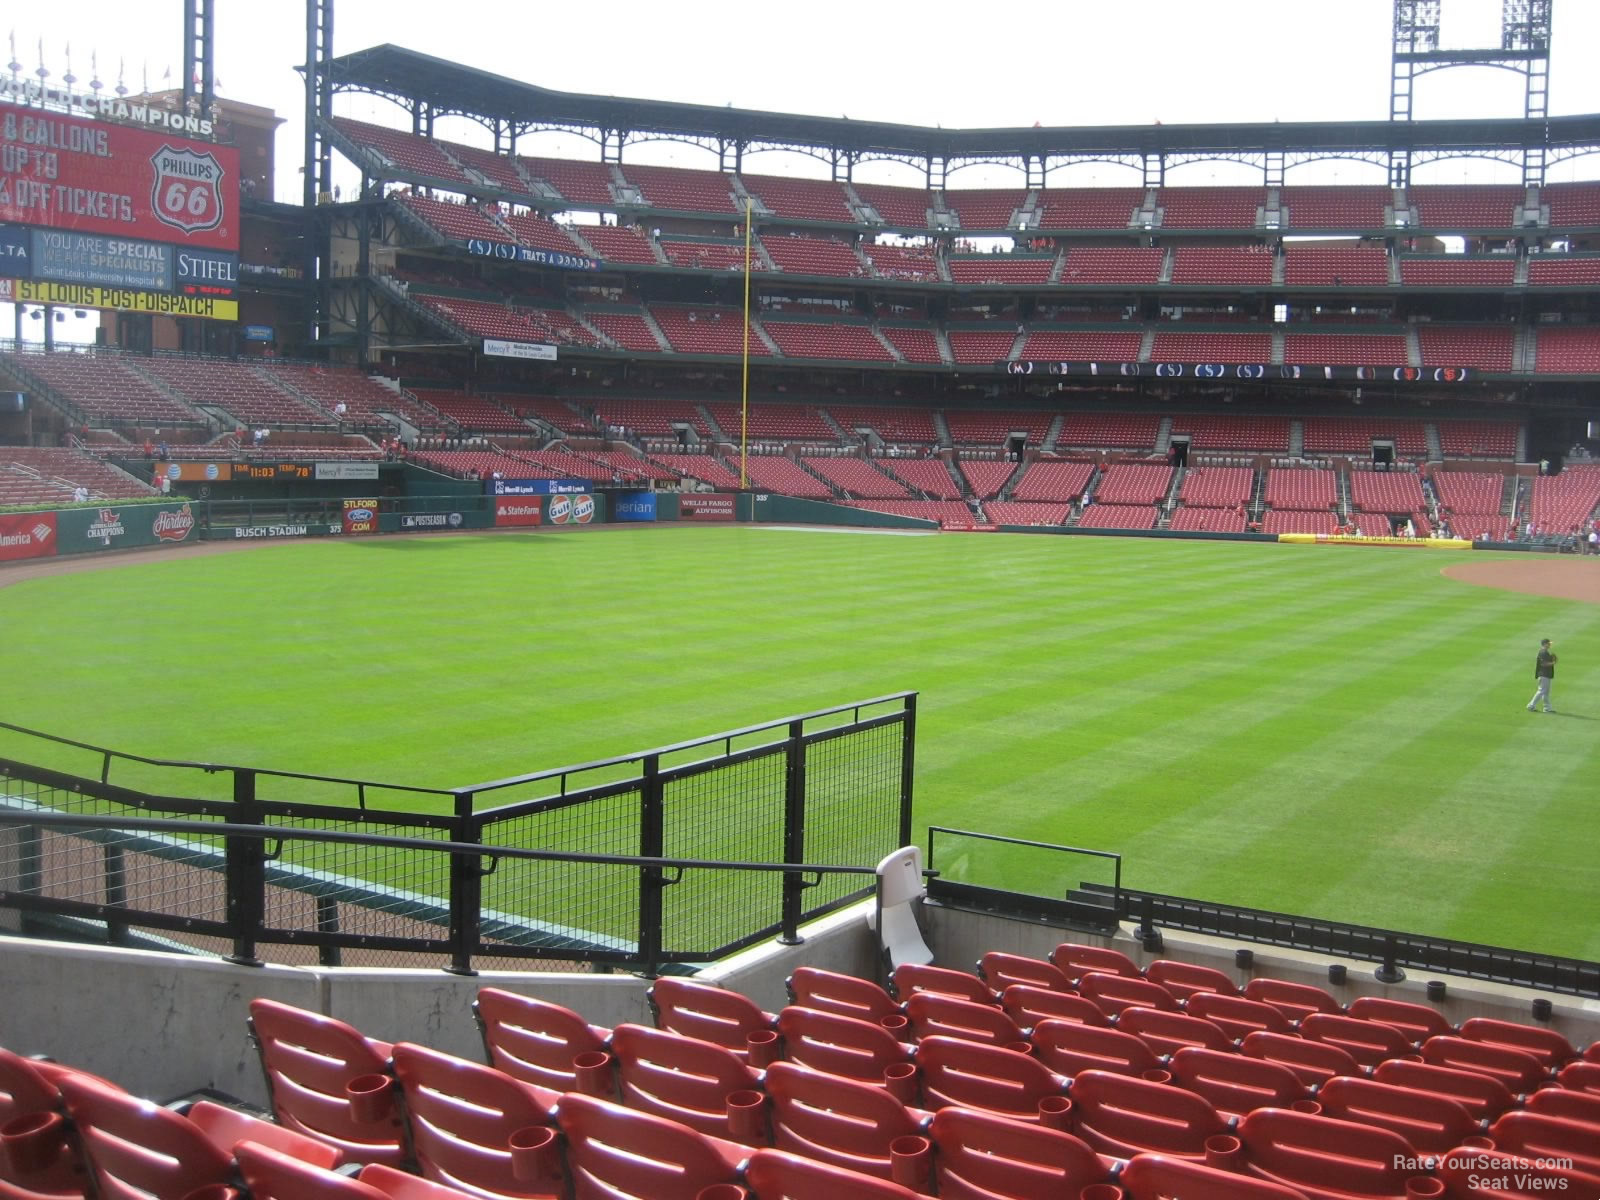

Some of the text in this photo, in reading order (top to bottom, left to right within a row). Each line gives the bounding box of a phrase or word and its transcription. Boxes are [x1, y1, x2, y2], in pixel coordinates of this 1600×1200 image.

[81, 94, 213, 135] CHAMPIONS
[23, 116, 113, 158] GALLONS.
[2, 144, 29, 173] UP
[162, 157, 213, 179] PHILLIPS
[16, 179, 51, 209] OFF
[56, 185, 137, 222] TICKETS.
[166, 183, 209, 215] 66
[43, 232, 165, 261] YOU ARE SPECIAL
[522, 249, 546, 263] THAT'S
[90, 254, 165, 273] SPECIALISTS
[178, 254, 237, 281] STIFEL
[42, 266, 155, 287] Saint Louis University Hospital
[21, 281, 44, 300] ST.
[50, 283, 94, 305] LOUIS
[101, 287, 214, 316] POST-DISPATCH
[487, 344, 506, 355] Mercy
[234, 464, 274, 477] TIME 11:03
[343, 500, 378, 508] STLFORD
[550, 501, 570, 517] Gulf
[573, 501, 593, 517] Gulf
[87, 526, 125, 538] CHAMPIONS
[235, 525, 307, 538] BUSCH STADIUM
